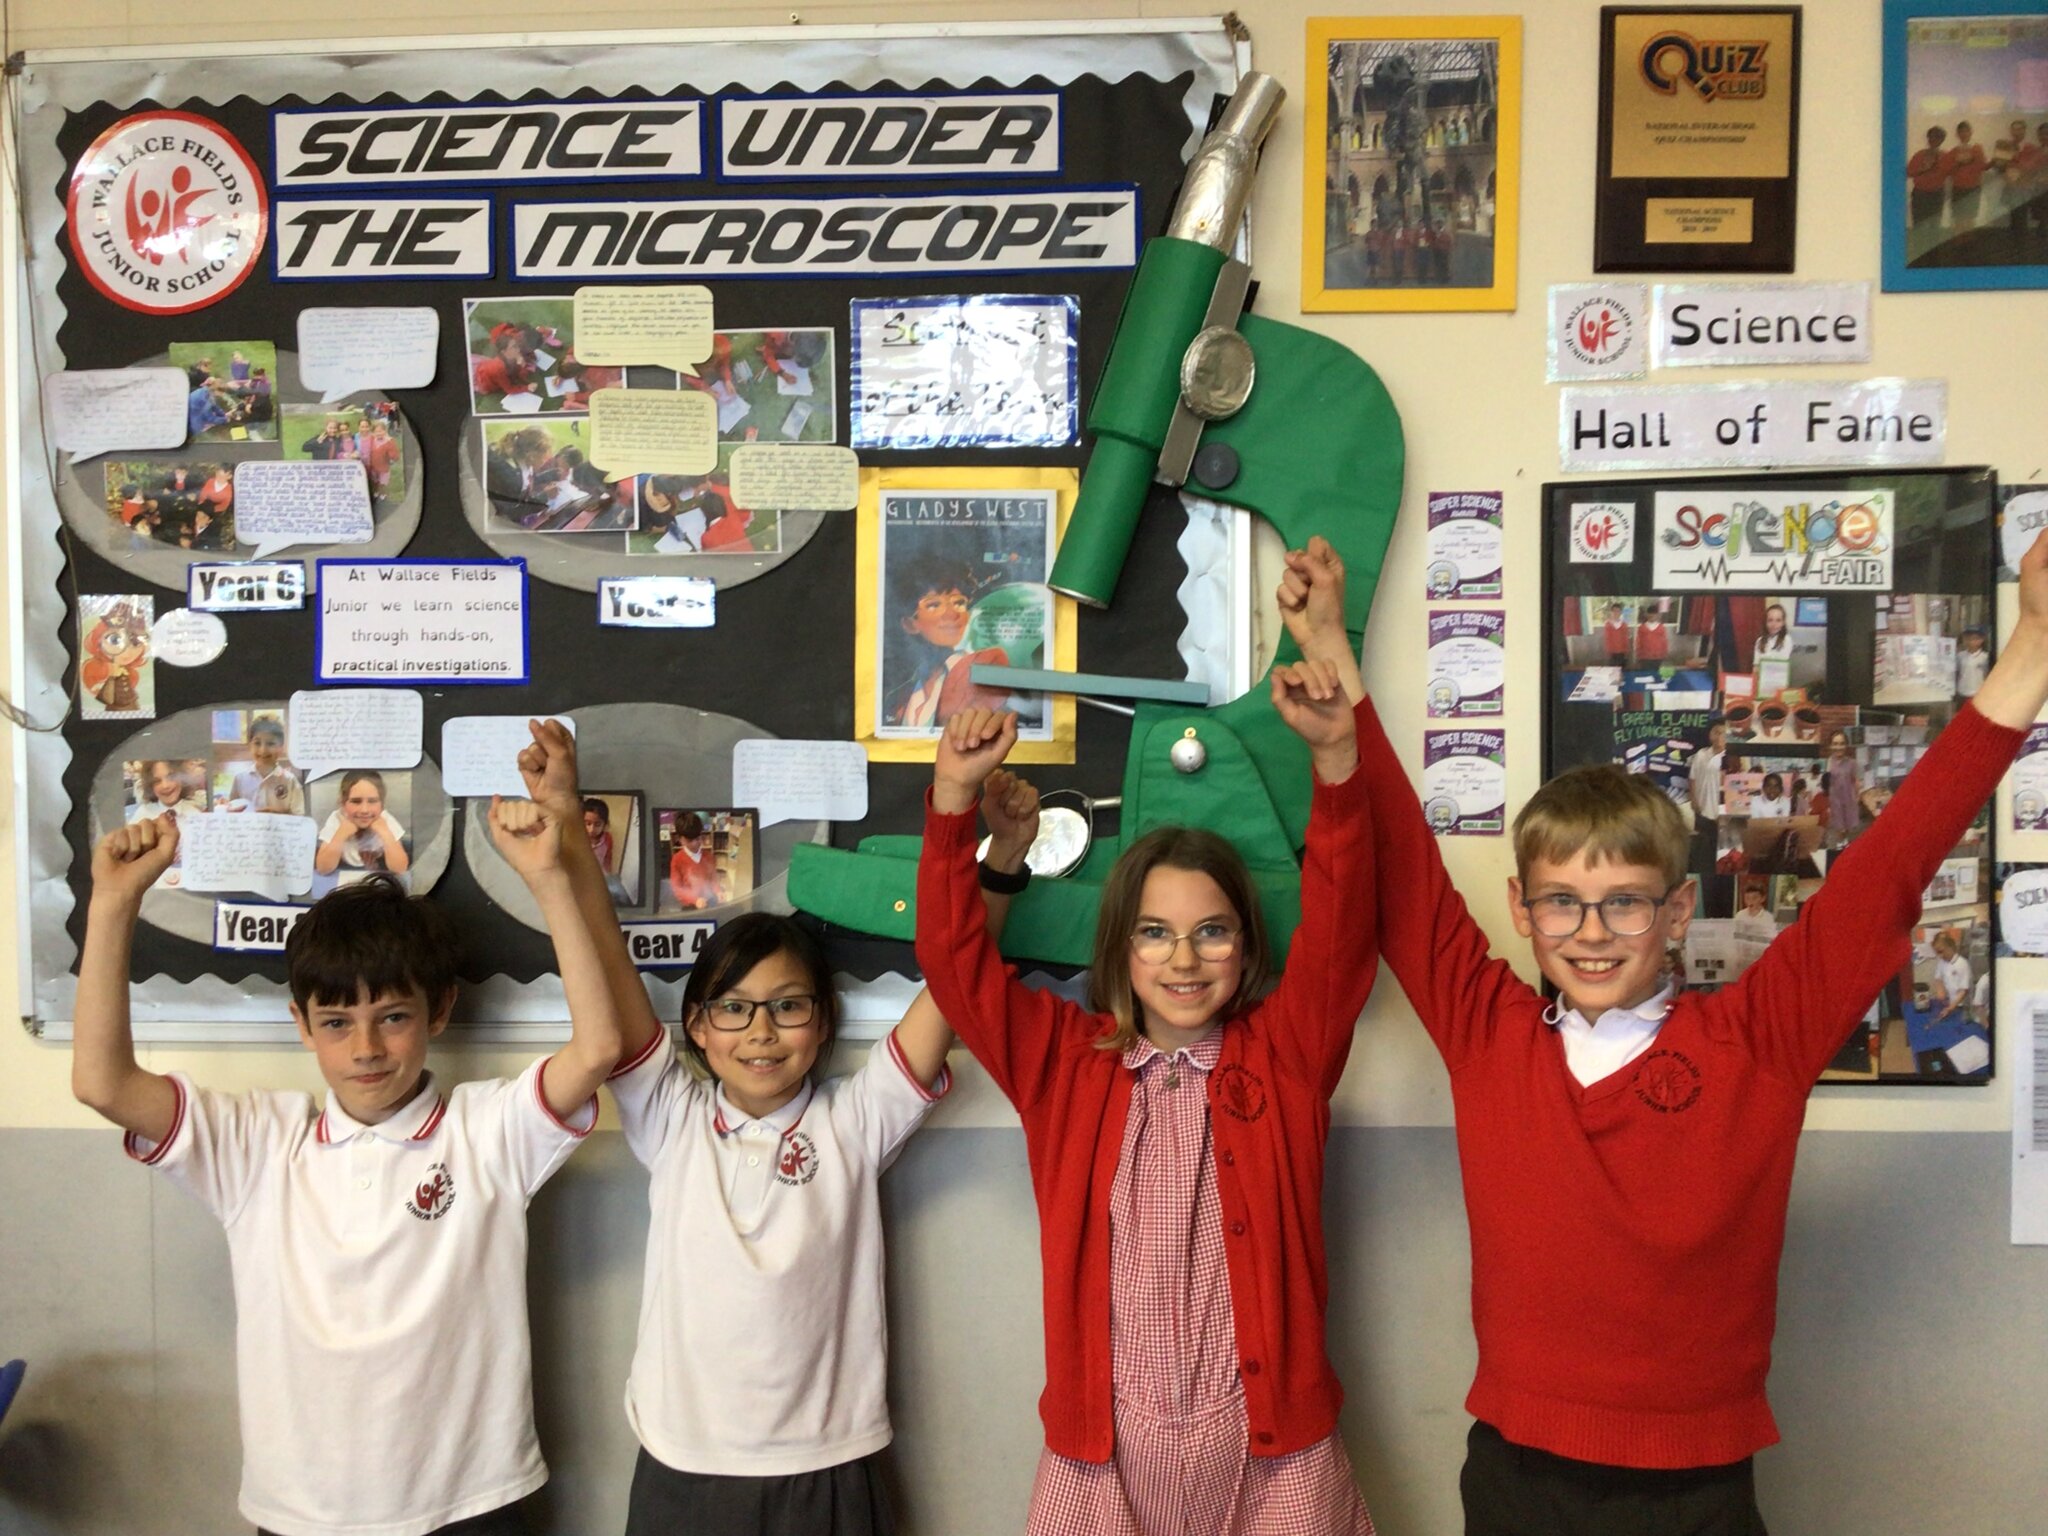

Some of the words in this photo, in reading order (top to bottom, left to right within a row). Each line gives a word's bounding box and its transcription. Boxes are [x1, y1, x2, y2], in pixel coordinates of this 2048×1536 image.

[1717, 80, 1760, 94] CLUB
[284, 110, 694, 177] SCIENCE
[728, 105, 1053, 166] UNDER
[182, 139, 243, 206] FIELDS
[285, 208, 484, 267] THE
[521, 202, 1129, 267] MICROSCOPE
[92, 230, 160, 292] JUNIOR
[167, 228, 241, 293] SCHOL
[1671, 304, 1857, 346] Science
[1573, 408, 1671, 450] Hall
[1716, 404, 1767, 445] of
[1806, 401, 1933, 443] Fame
[887, 500, 975, 519] GLADYS
[986, 500, 1046, 519] WEST
[1460, 495, 1501, 511] SCIENCE
[348, 568, 366, 581] At
[379, 568, 440, 581] Wallace
[452, 567, 496, 581] Fields
[1821, 559, 1884, 585] FAIR
[199, 571, 269, 602] Year
[325, 598, 368, 614] Junior
[381, 602, 402, 612] we
[414, 598, 453, 611] learn
[465, 598, 519, 611] science
[1462, 613, 1502, 630] SCIENCE
[352, 628, 409, 646] through
[420, 628, 494, 644] hands-on,
[332, 658, 398, 675] practical
[402, 658, 511, 676] investigations.
[1660, 712, 1708, 728] PLANE
[1461, 732, 1502, 749] SCIENCE
[1614, 728, 1632, 745] FLY
[1636, 725, 1682, 740] LONGER
[2015, 887, 2048, 909] SCIE
[223, 911, 288, 943] Year
